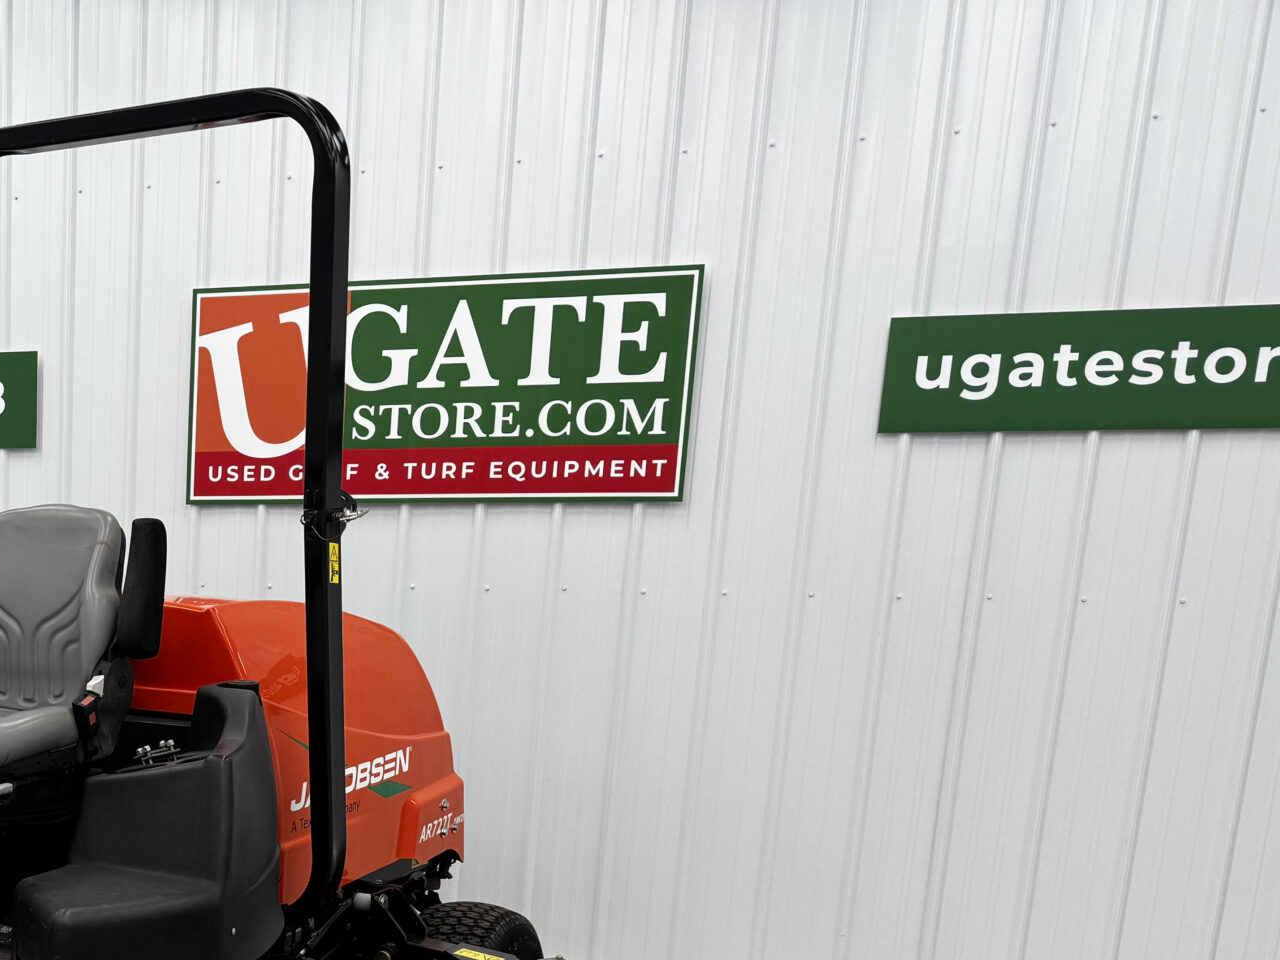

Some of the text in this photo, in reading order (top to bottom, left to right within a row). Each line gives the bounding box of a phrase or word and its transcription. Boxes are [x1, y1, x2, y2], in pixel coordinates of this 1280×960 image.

[351, 398, 670, 441] STORE.COM
[207, 457, 669, 483] USED GF & TURF EQUIPMENT
[290, 745, 412, 812] JOBSEN
